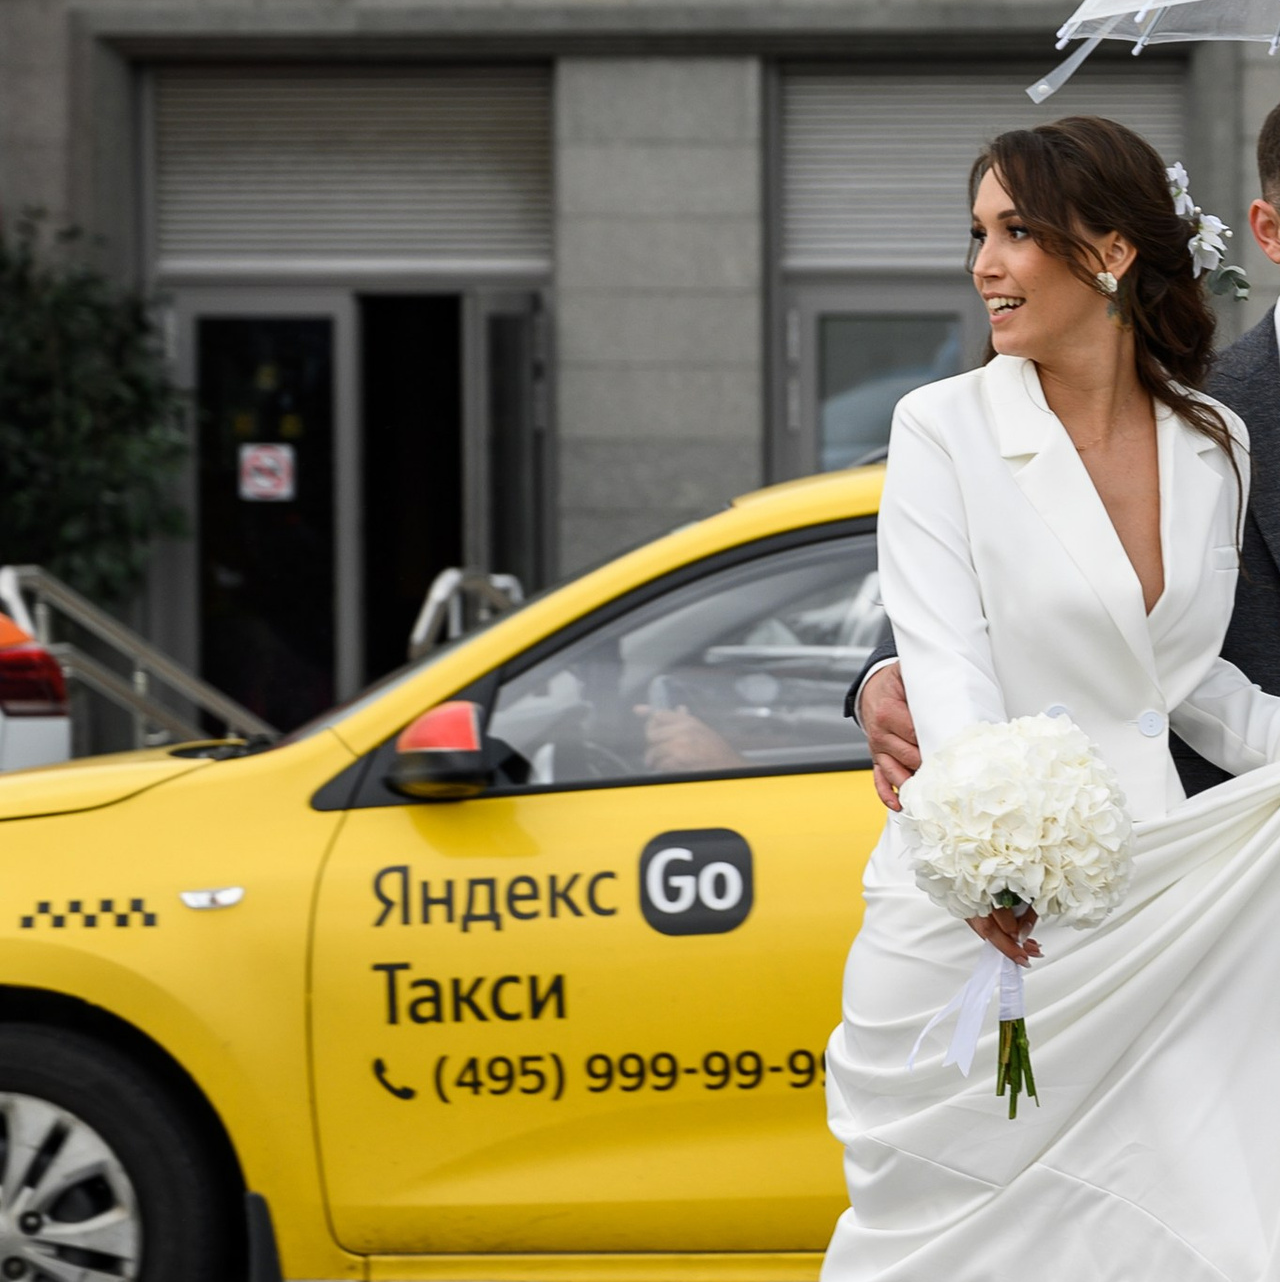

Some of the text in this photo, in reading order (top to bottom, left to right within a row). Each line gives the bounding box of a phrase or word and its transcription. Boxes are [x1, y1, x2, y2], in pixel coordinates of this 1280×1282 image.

[372, 846, 744, 932] Яндекс Go
[371, 962, 568, 1025] Такси
[434, 1048, 827, 1103] (495) 999-99-9
